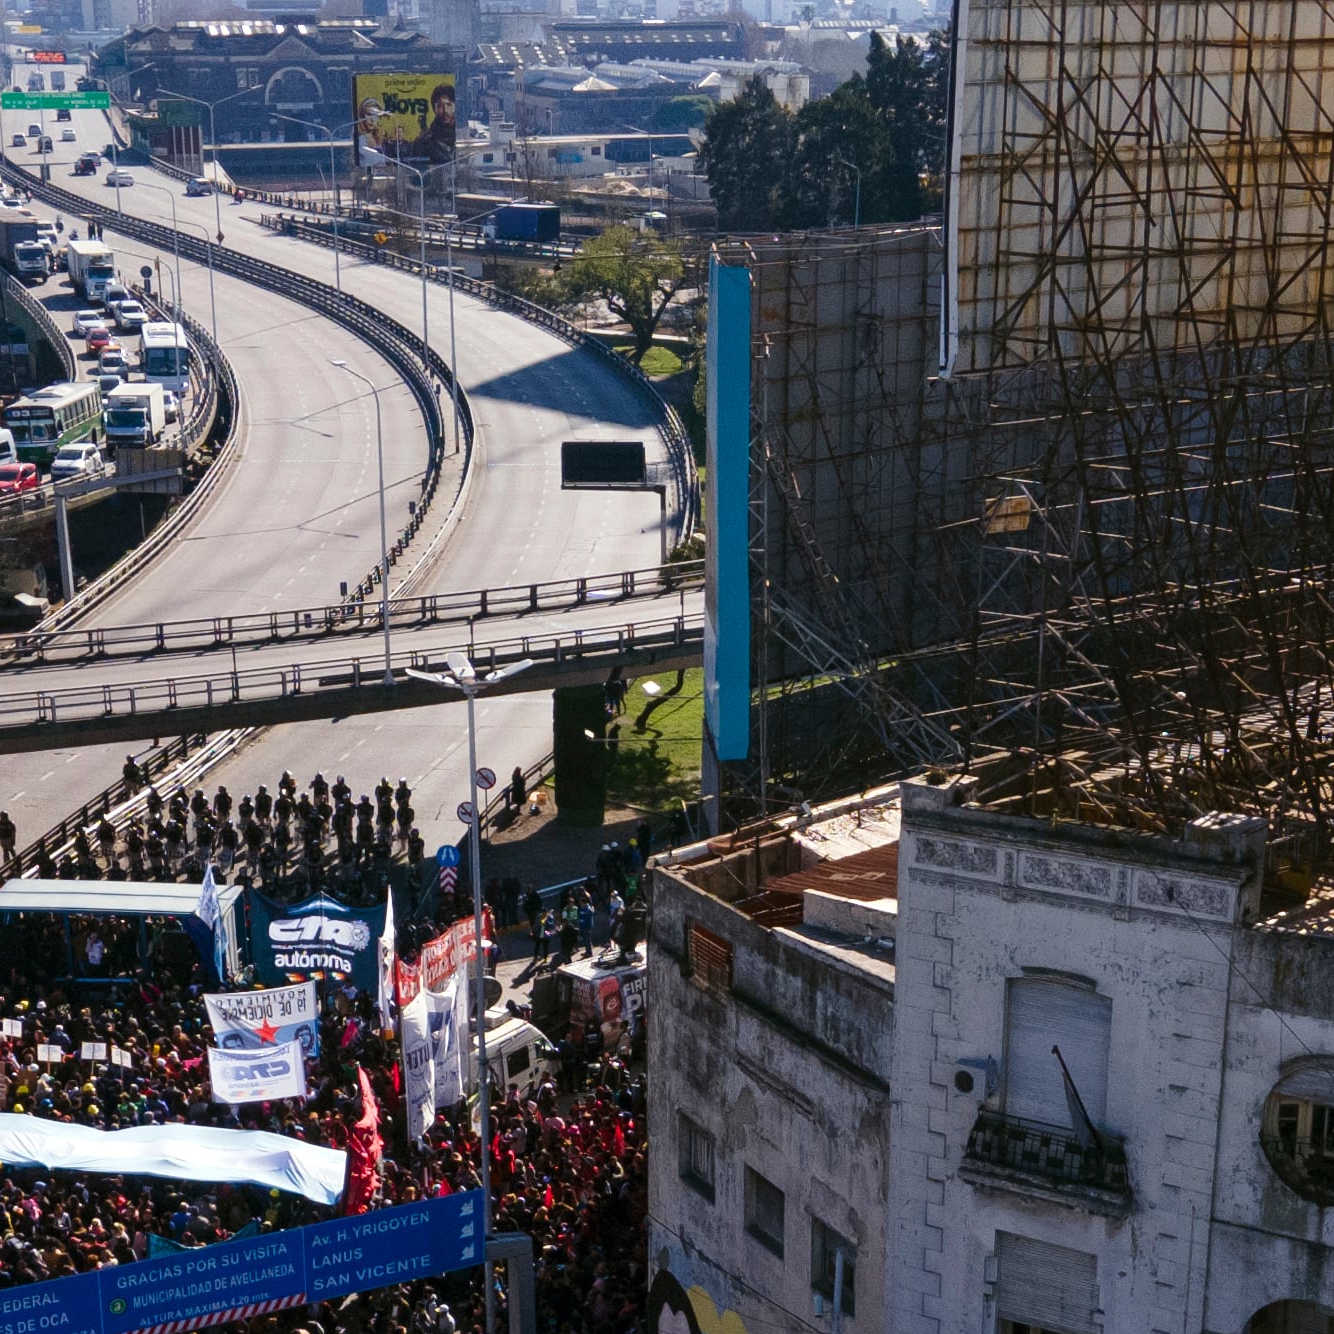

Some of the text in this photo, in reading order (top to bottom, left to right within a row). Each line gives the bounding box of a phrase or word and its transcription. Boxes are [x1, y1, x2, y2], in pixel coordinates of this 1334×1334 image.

[275, 950, 352, 973] autónoma
[312, 1211, 430, 1248] Av. H. YRIGOYEN
[117, 1243, 287, 1289] GRACIAS POR SU VISITA
[312, 1248, 363, 1269] LANUS
[314, 1254, 431, 1290] SAN VICENTE
[133, 1263, 295, 1309] MUNICIPALIDAD DE AVELLANEDA
[18, 1318, 36, 1330] DE
[39, 1312, 69, 1327] OCA
[185, 1301, 228, 1316] MAXIMA
